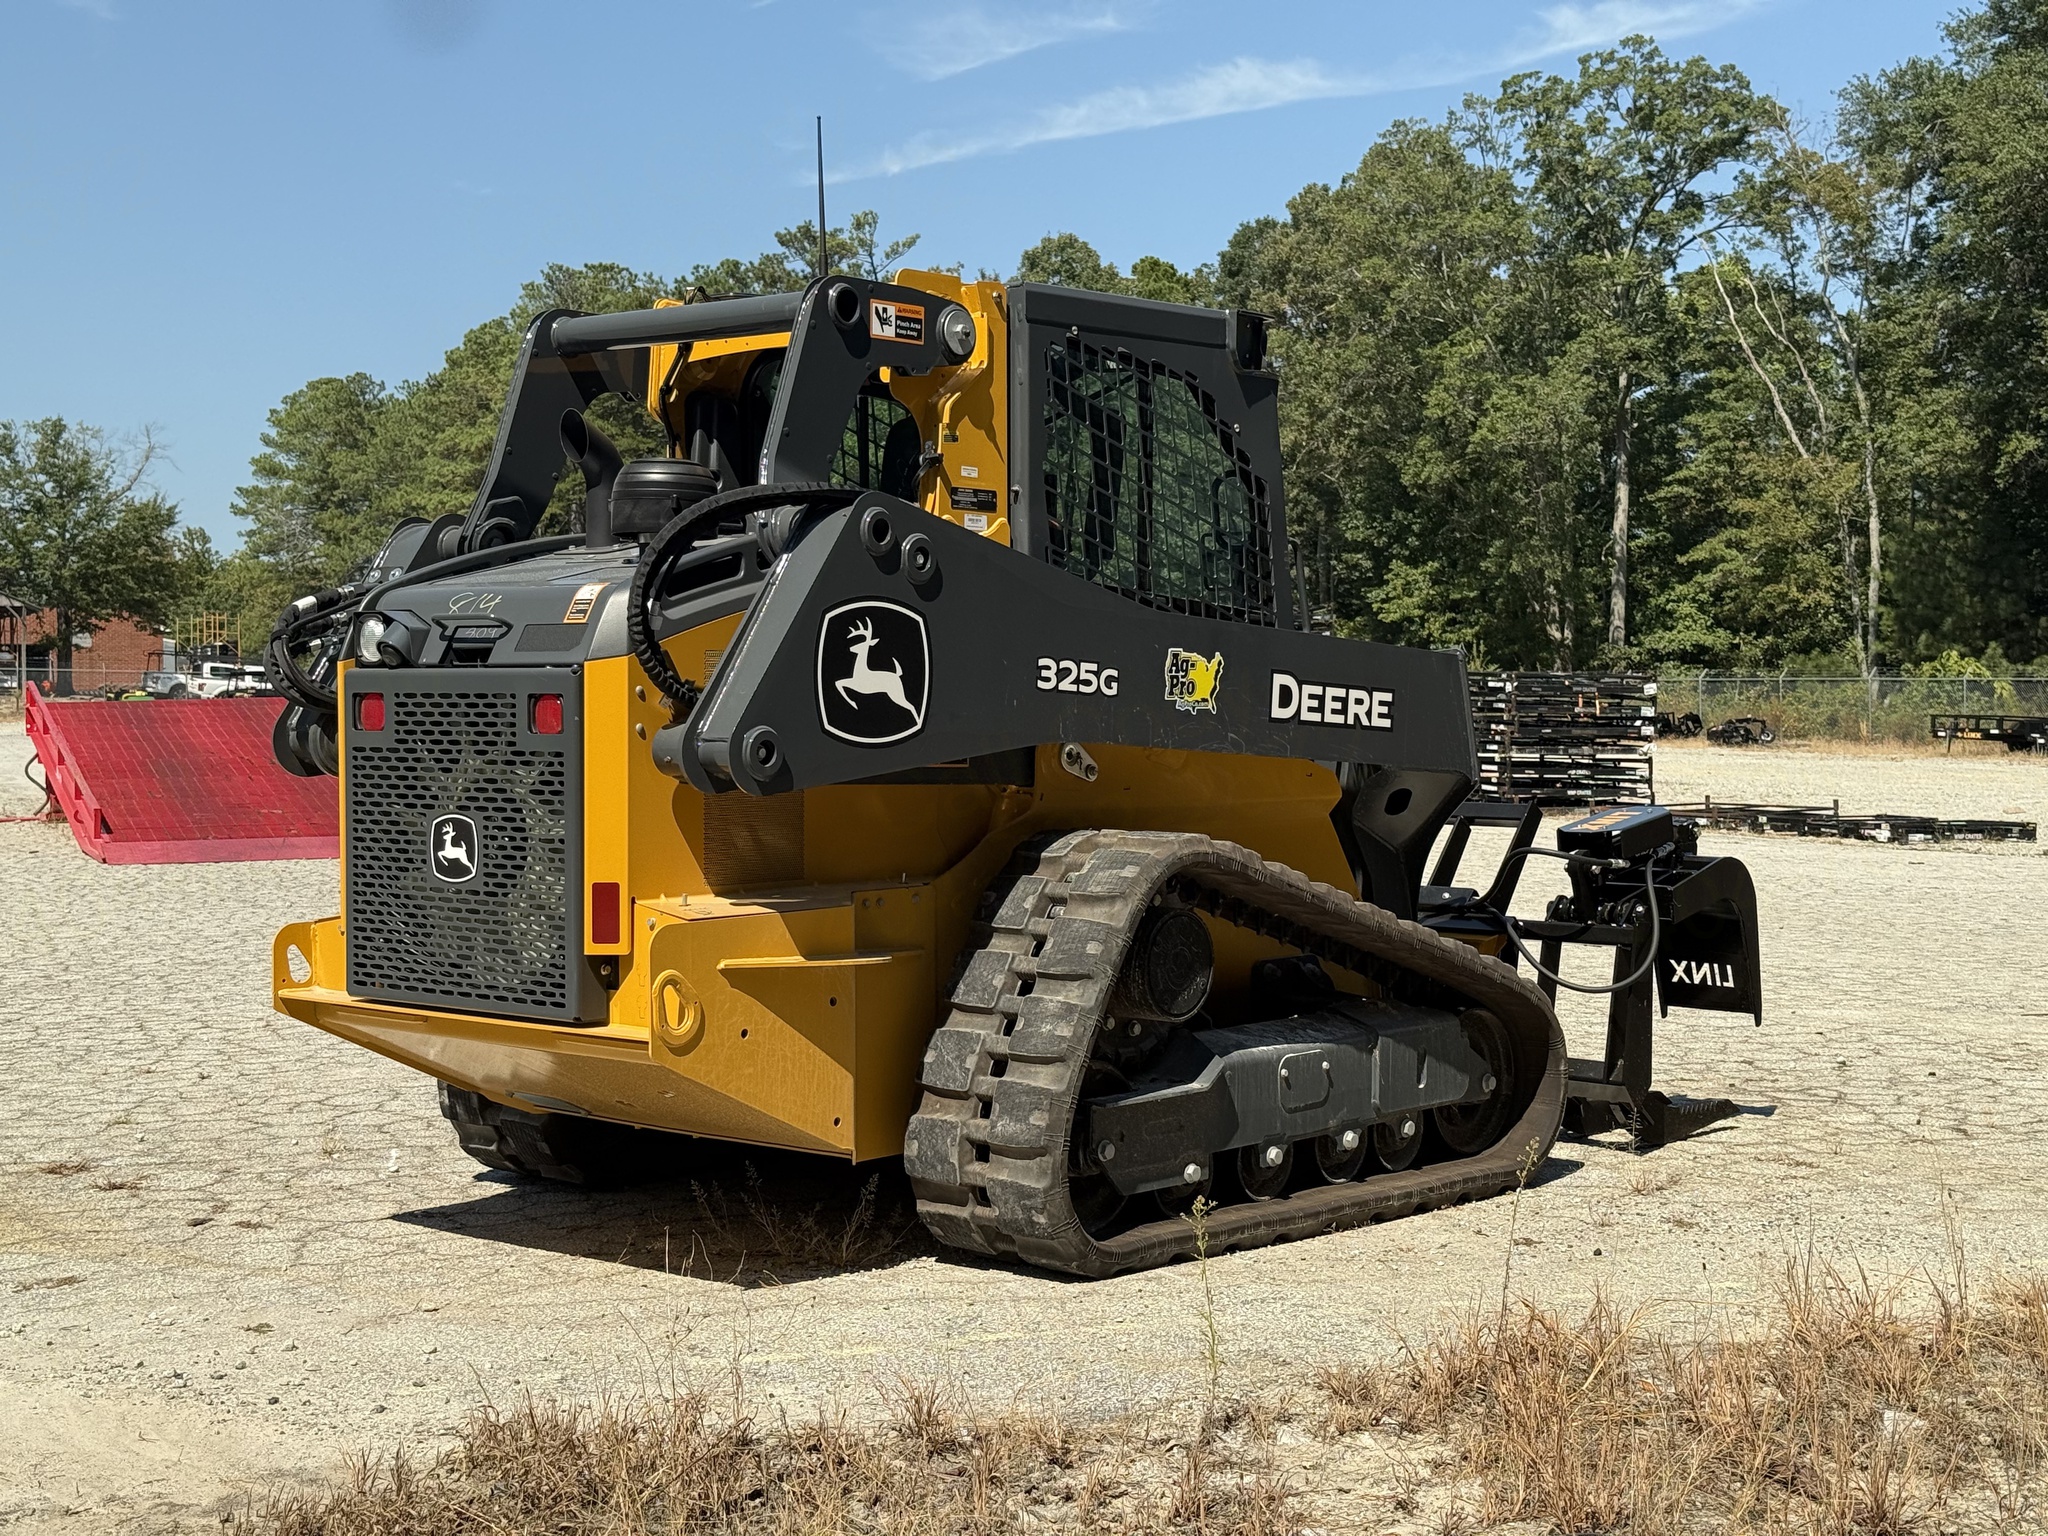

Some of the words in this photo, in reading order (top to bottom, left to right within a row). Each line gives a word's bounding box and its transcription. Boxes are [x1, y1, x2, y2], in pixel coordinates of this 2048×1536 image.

[897, 320, 910, 328] Pinch
[1036, 657, 1119, 696] 325G
[1168, 651, 1196, 679] Ag-
[1168, 674, 1196, 696] Pro
[1270, 672, 1394, 728] DEERE
